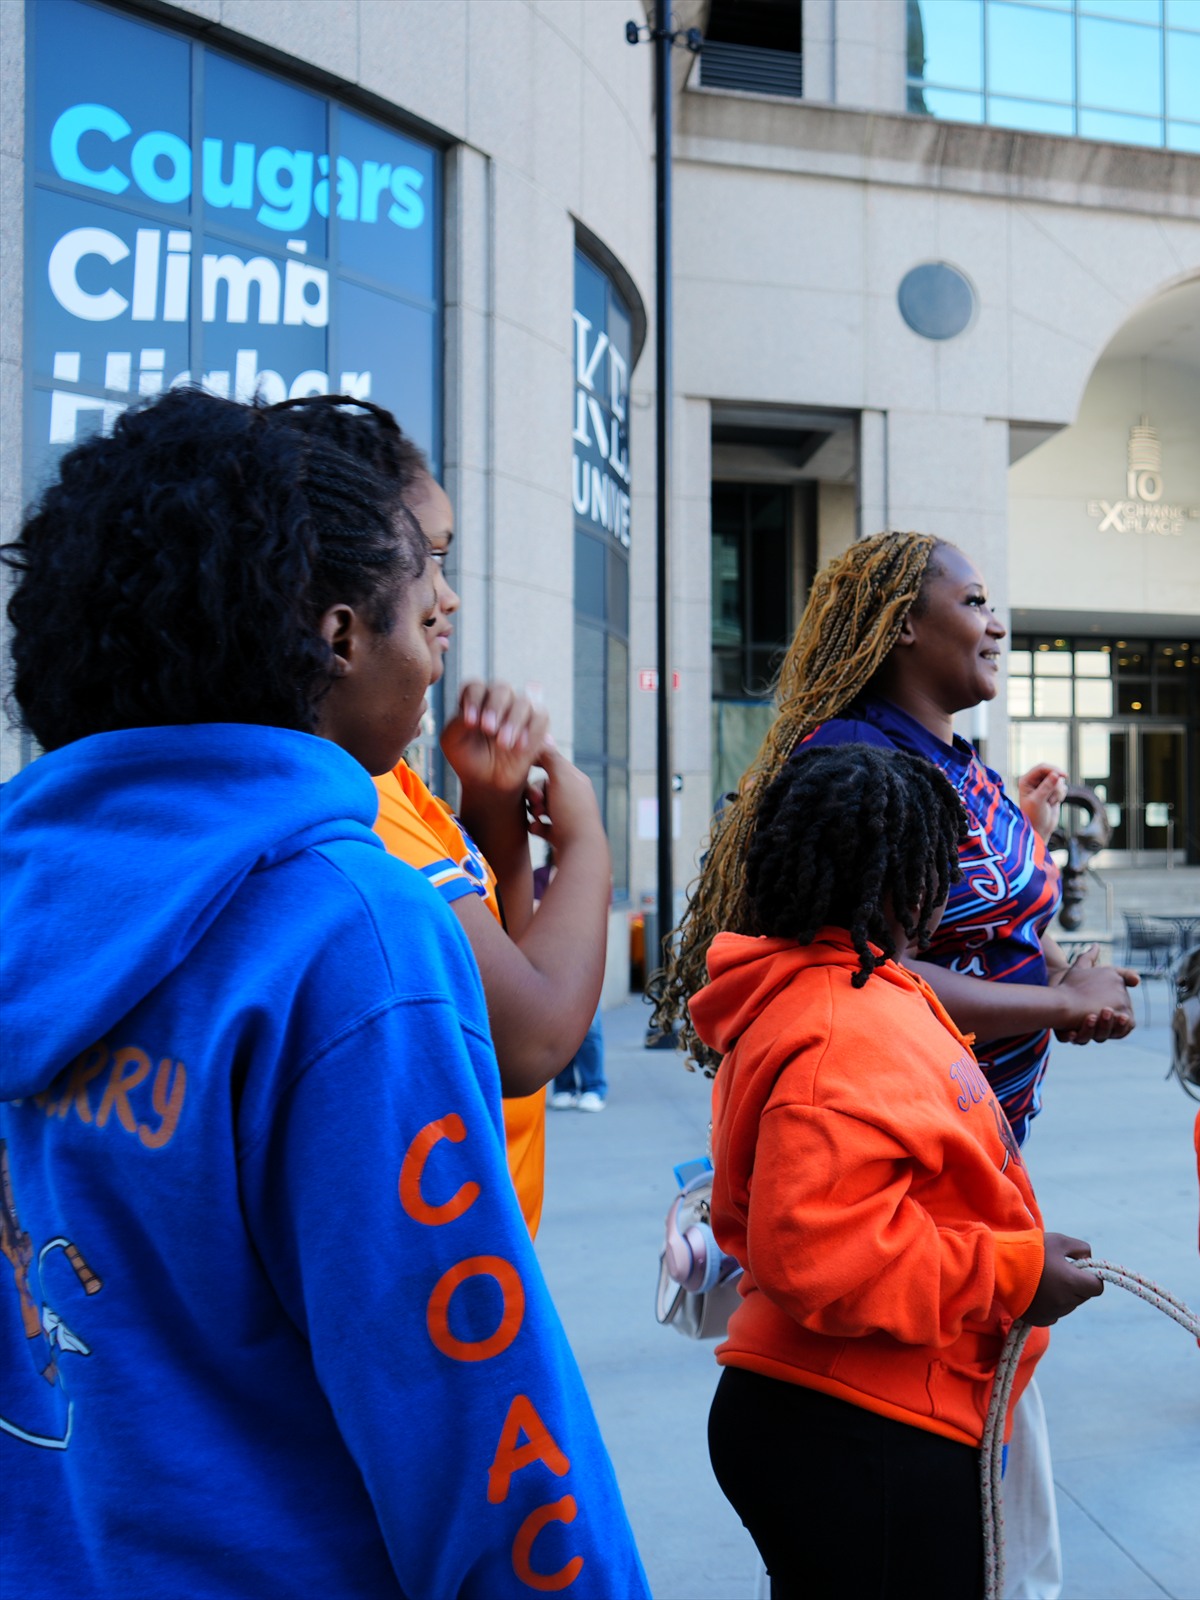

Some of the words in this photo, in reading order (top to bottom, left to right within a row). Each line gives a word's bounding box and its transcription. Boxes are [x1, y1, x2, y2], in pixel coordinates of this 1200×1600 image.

[49, 102, 425, 232] Cougars
[48, 225, 330, 328] Climb
[398, 1112, 584, 1592] COAC
